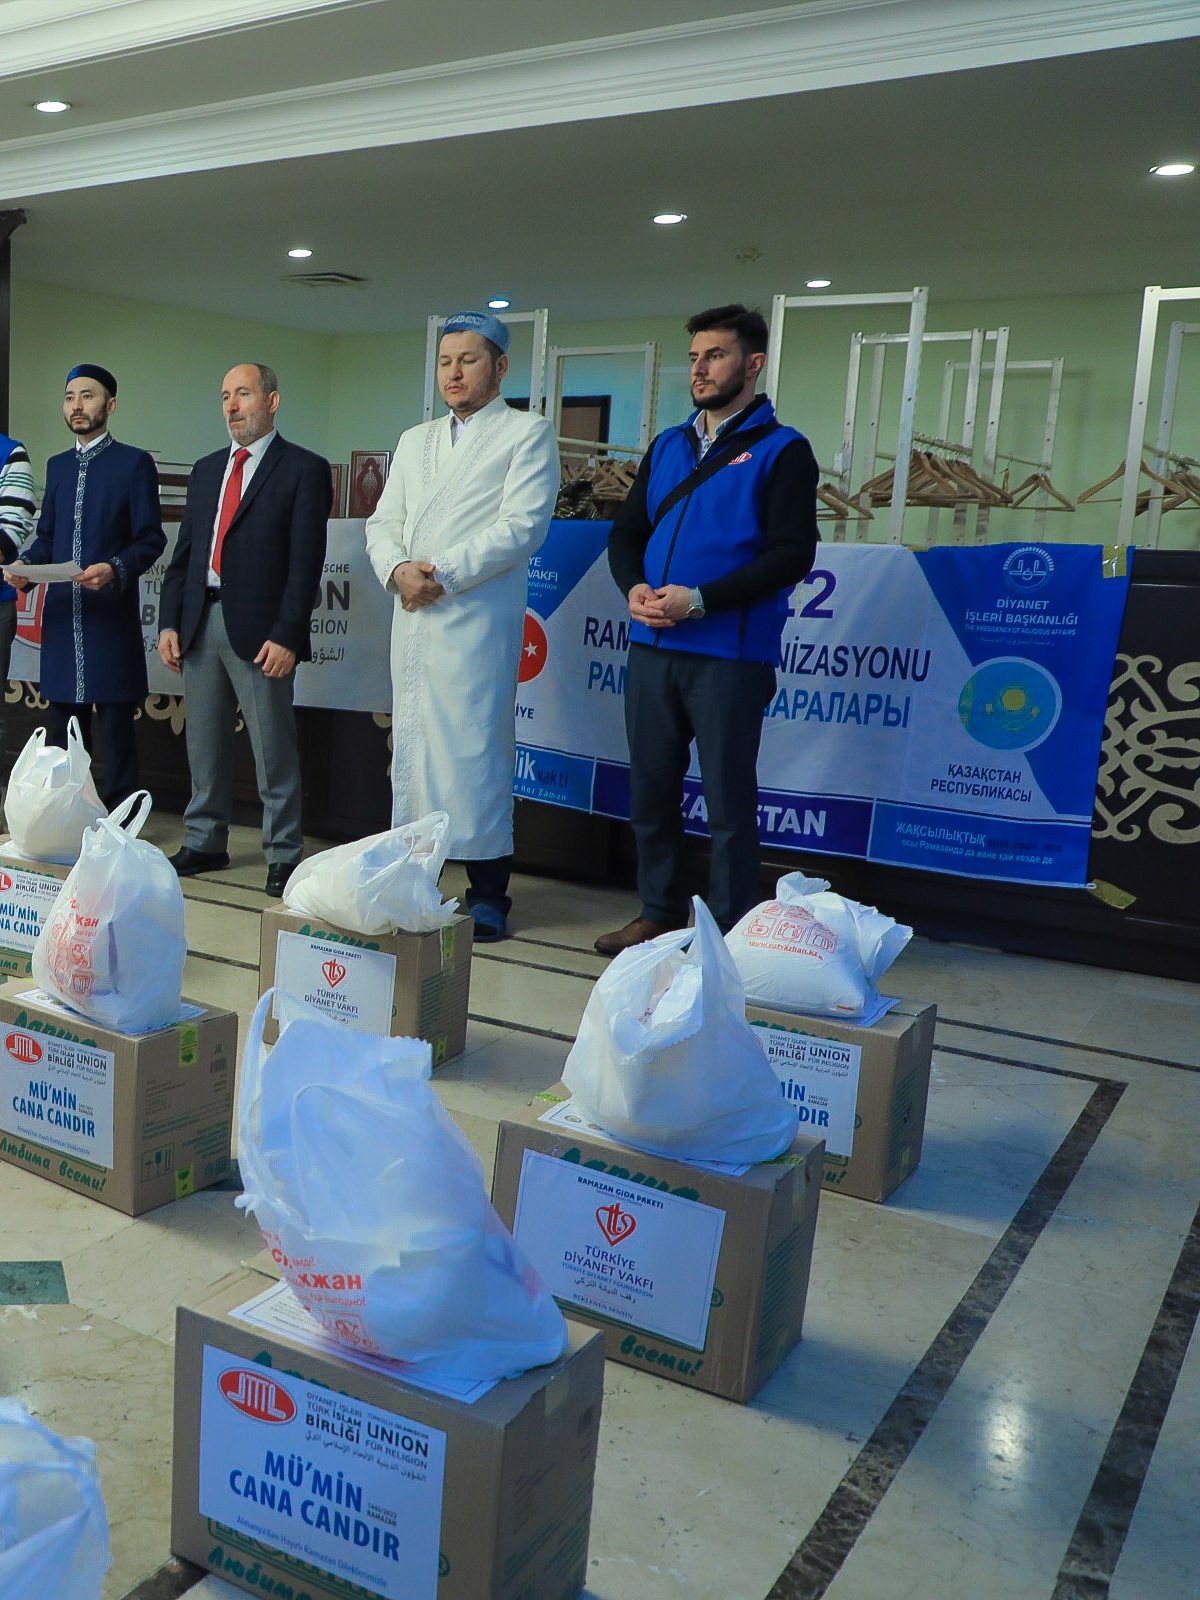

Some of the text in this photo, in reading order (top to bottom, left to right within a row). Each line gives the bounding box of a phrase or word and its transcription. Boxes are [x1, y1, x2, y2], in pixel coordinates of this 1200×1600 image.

[323, 564, 350, 573] SCHE
[996, 596, 1050, 610] DİYANET
[310, 618, 348, 635] GION
[965, 608, 1078, 627] İŞLERİ BAŞKANLIĞI
[774, 635, 932, 683] NİZASYONU
[515, 703, 535, 719] İYE
[763, 688, 911, 728] АРАЛАРЫ
[538, 767, 569, 788] vakti
[947, 762, 1022, 784] ҚАЗАҚСТАН
[930, 778, 1032, 803] РЕСПУБЛИКАСЫ
[0, 902, 38, 922] MÜ'MİN
[13, 921, 43, 938] CAND
[304, 993, 359, 1014] DİYANET VAKFI
[317, 988, 347, 1003] TÜRKİYE
[47, 1053, 107, 1071] BİRLİĞİ UNION
[768, 1045, 850, 1063] BİRLİĞİ UNION
[29, 1080, 77, 1111] MÜ'MİN
[12, 1096, 96, 1138] CANA CANDIR
[0, 1136, 51, 1169] Любима
[59, 1160, 108, 1192] всеми!
[577, 1176, 614, 1194] RAMAZAN
[615, 1188, 635, 1201] GIDA
[585, 1243, 636, 1271] TÜRKİYE
[564, 1250, 654, 1291] DİYANET VAKFI
[620, 1334, 704, 1377] всеми!
[306, 1391, 337, 1409] DİYANET
[307, 1401, 361, 1428] TÜRK İSLAM
[305, 1413, 360, 1444] BİRLİĞİ
[366, 1421, 429, 1458] UNION
[365, 1439, 427, 1471] FÜR RELIGION
[264, 1450, 362, 1513] MÜ'MİN
[229, 1469, 400, 1562] CANA CANDIR
[366, 1510, 397, 1527] RAMAZAN
